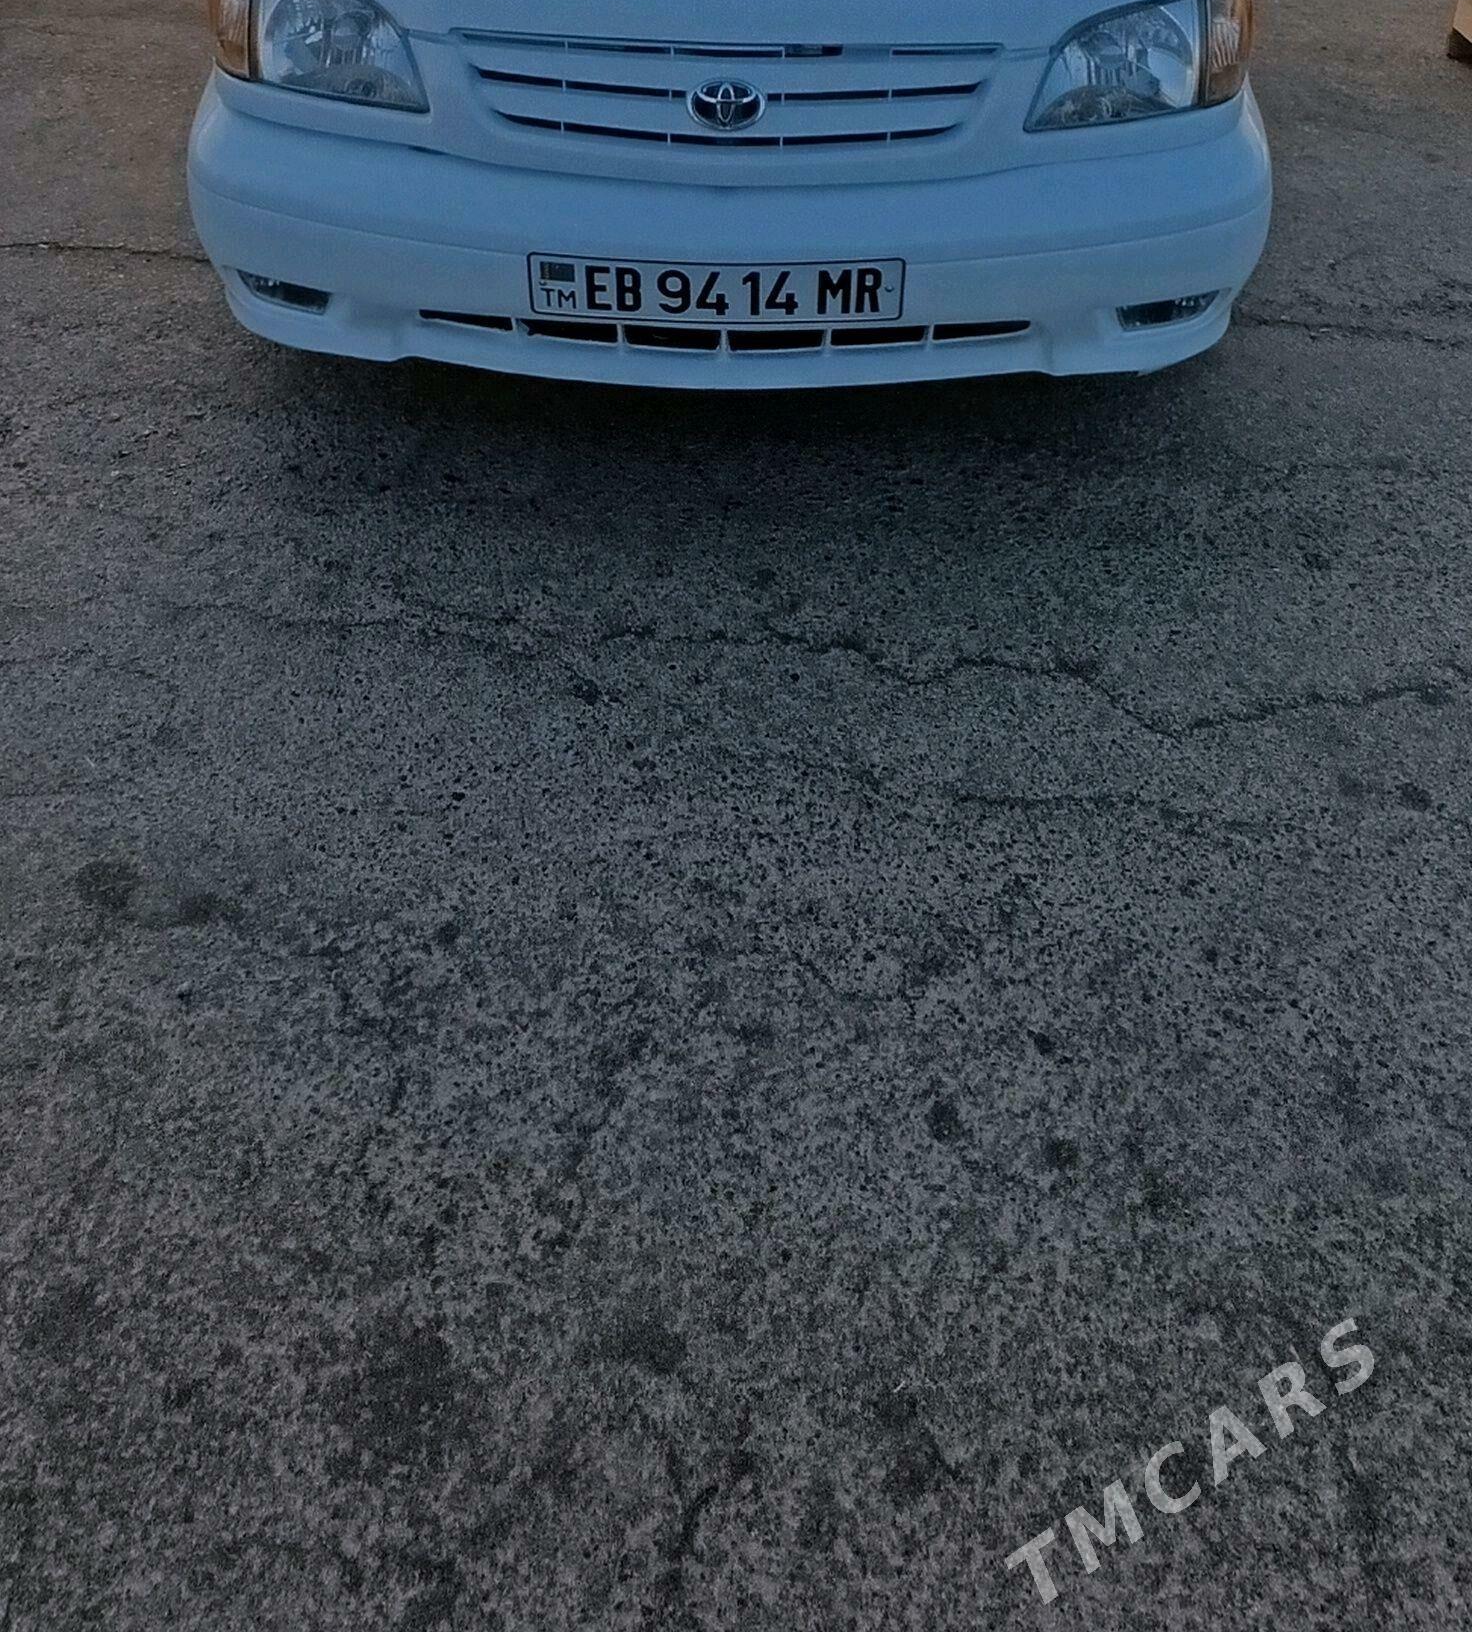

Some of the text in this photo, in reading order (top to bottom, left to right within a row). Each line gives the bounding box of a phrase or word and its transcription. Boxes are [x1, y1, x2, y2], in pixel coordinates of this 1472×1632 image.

[540, 287, 577, 310] TM
[585, 265, 883, 316] EB 94 14 MR
